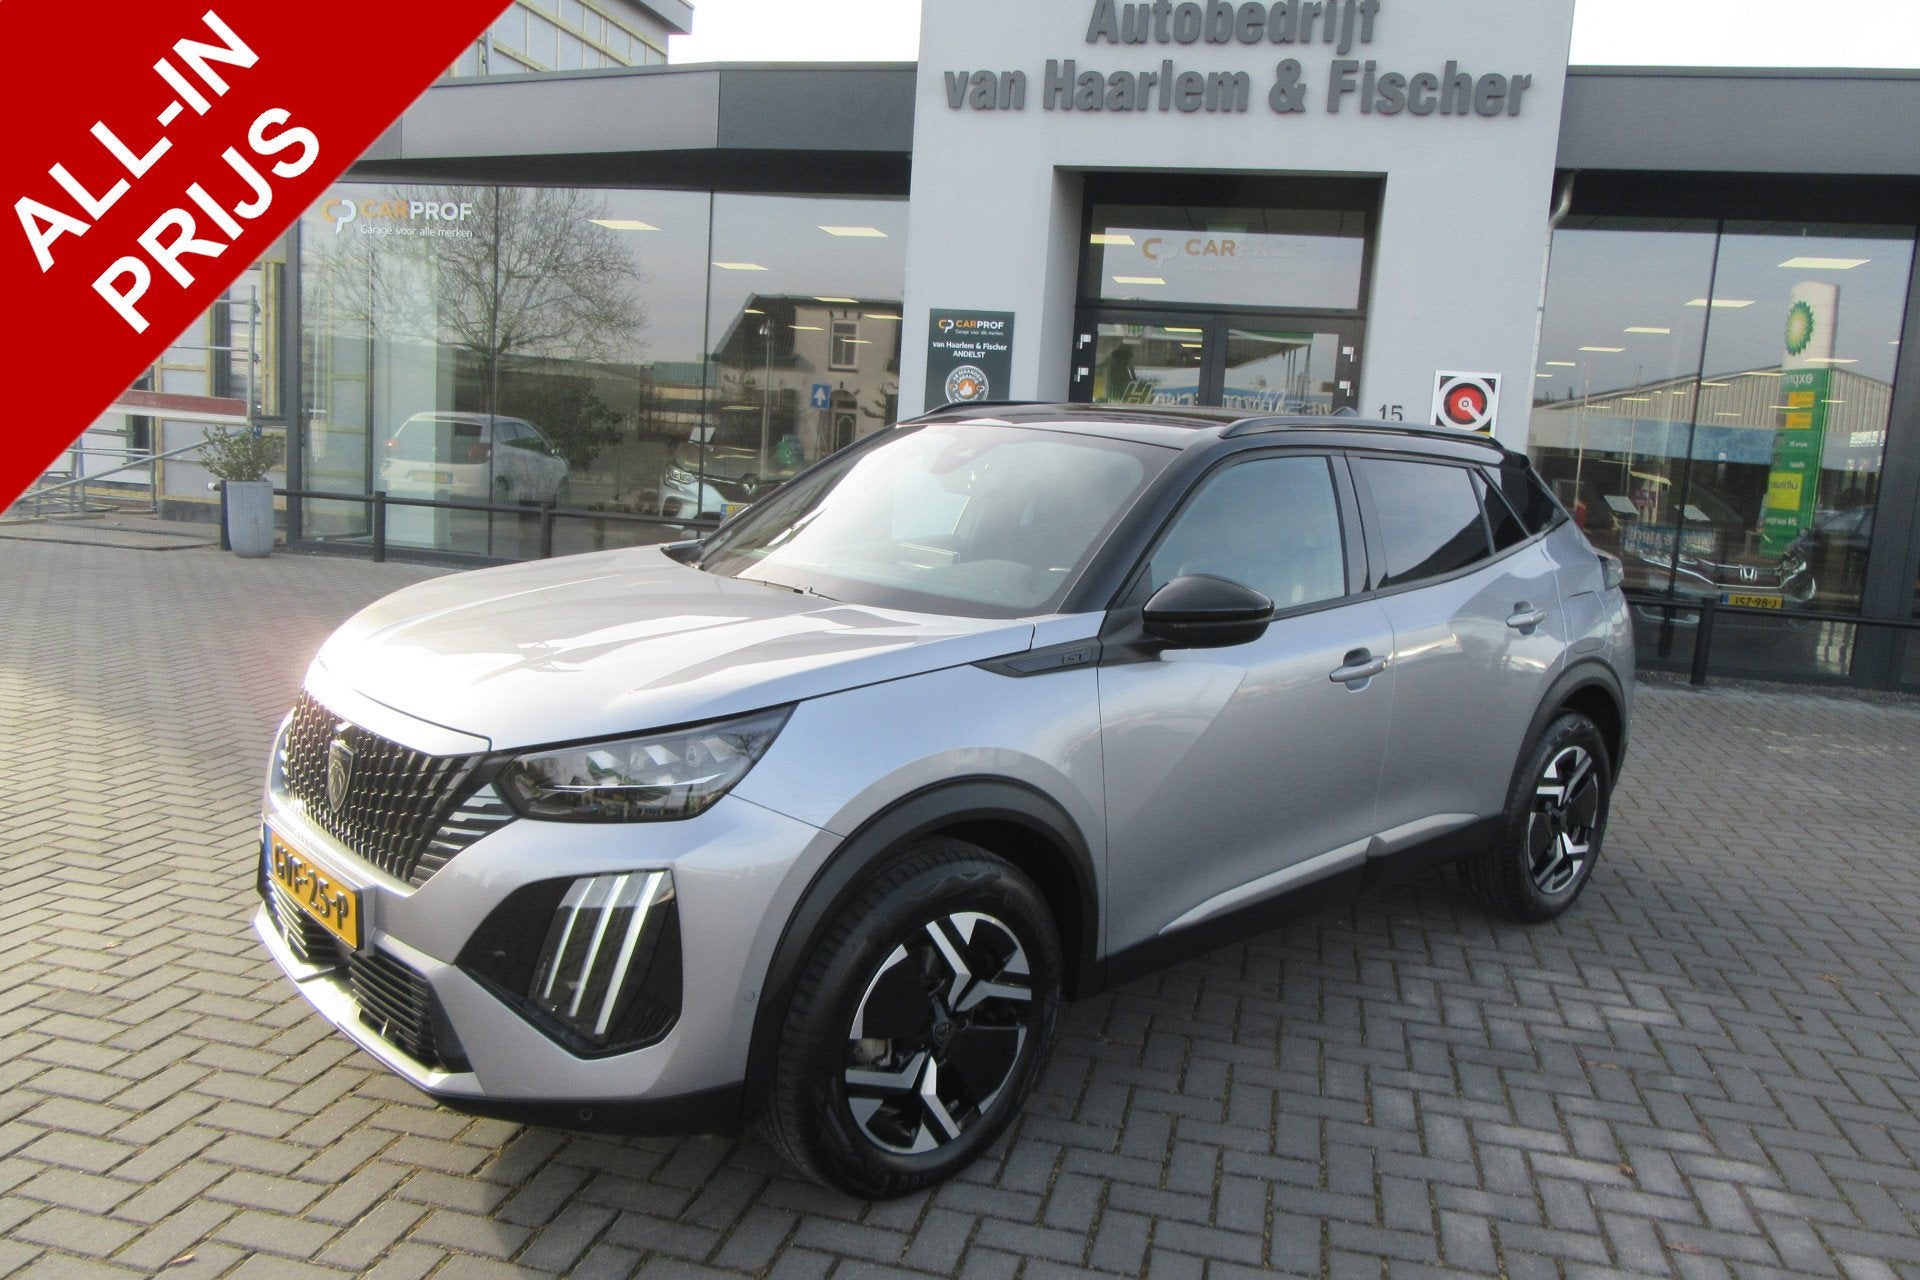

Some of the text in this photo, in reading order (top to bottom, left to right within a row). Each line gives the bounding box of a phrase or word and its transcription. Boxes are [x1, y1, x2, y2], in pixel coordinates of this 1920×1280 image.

[1085, 0, 1381, 54] Autobedrijf
[944, 58, 1532, 116] van Haarlem & Fischer
[362, 199, 473, 221] CARPROF
[361, 224, 473, 238] Garage voor alle merken
[956, 320, 1004, 329] CARPROF
[946, 341, 974, 349] Haarlem
[983, 343, 1008, 351] Fischer
[953, 350, 986, 358] ANDELST
[1379, 404, 1404, 422] 15
